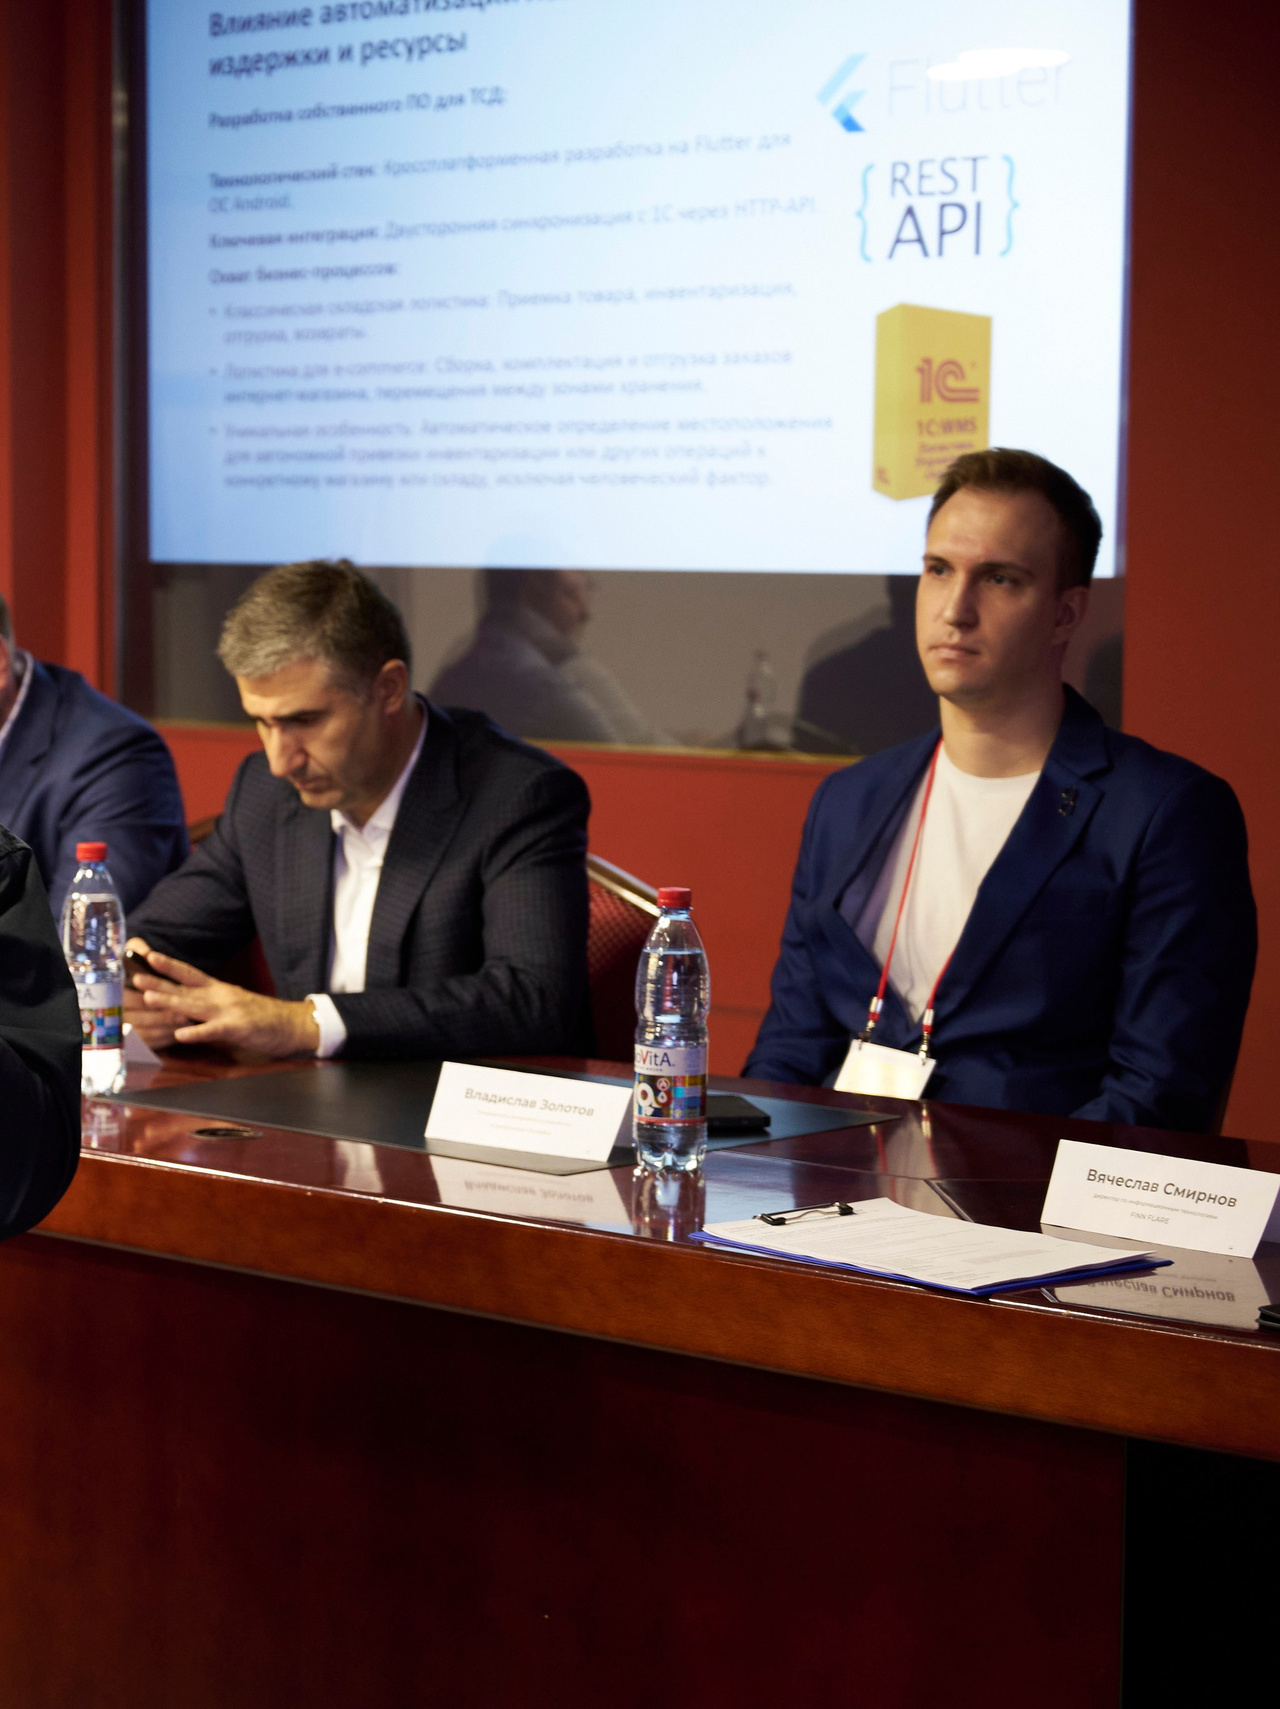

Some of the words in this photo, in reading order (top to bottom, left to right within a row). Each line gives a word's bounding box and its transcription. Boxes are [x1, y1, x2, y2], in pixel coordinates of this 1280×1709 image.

[209, 6, 314, 37] Влияние
[209, 46, 330, 78] издержки
[337, 43, 354, 63] и
[360, 31, 468, 67] ресурсы
[434, 93, 466, 112] для
[563, 140, 664, 168] разработка
[668, 139, 690, 156] на
[693, 133, 753, 154] Flutter
[756, 133, 792, 152] для
[890, 155, 990, 200] REST
[887, 201, 983, 260] API
[464, 1087, 537, 1110] Владислав
[539, 1099, 595, 1118] Золотов
[1086, 1168, 1159, 1194] Вячеслав
[1163, 1182, 1238, 1209] Смирнов
[1130, 1211, 1146, 1220] FINN
[1147, 1214, 1170, 1225] FLARE
